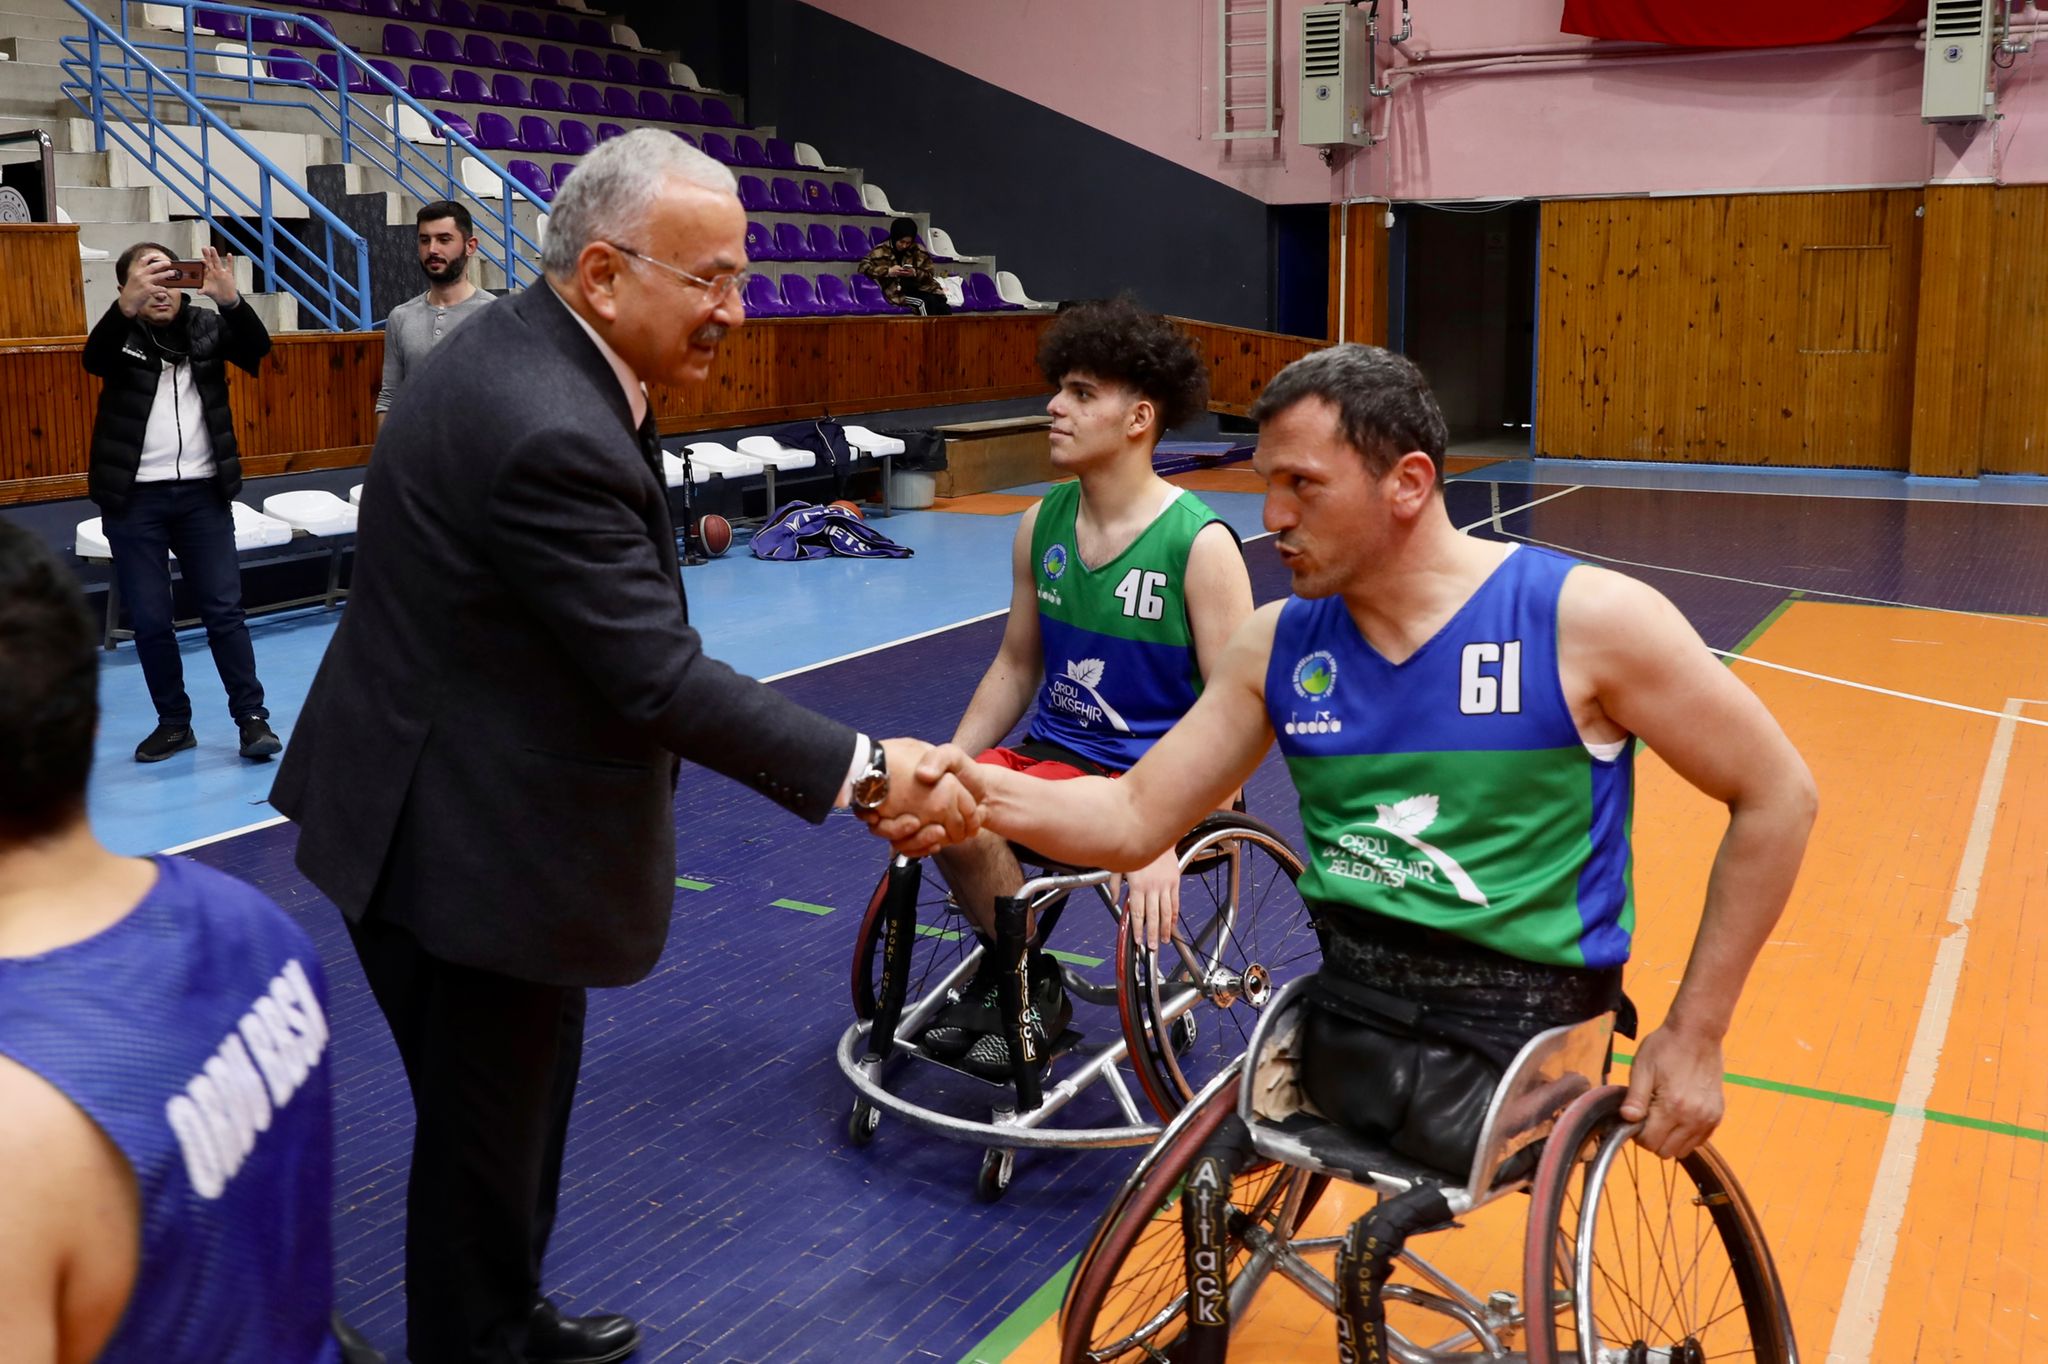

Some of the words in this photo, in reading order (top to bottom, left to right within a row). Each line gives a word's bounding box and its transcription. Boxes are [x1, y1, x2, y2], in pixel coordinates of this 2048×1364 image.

[1114, 567, 1168, 620] 46
[1054, 681, 1078, 698] ORDU
[1460, 640, 1521, 715] 61
[1338, 834, 1389, 855] ORDU
[887, 920, 898, 962] SPORT
[1193, 1161, 1219, 1322] Attack
[1359, 1237, 1378, 1308] SPORT
